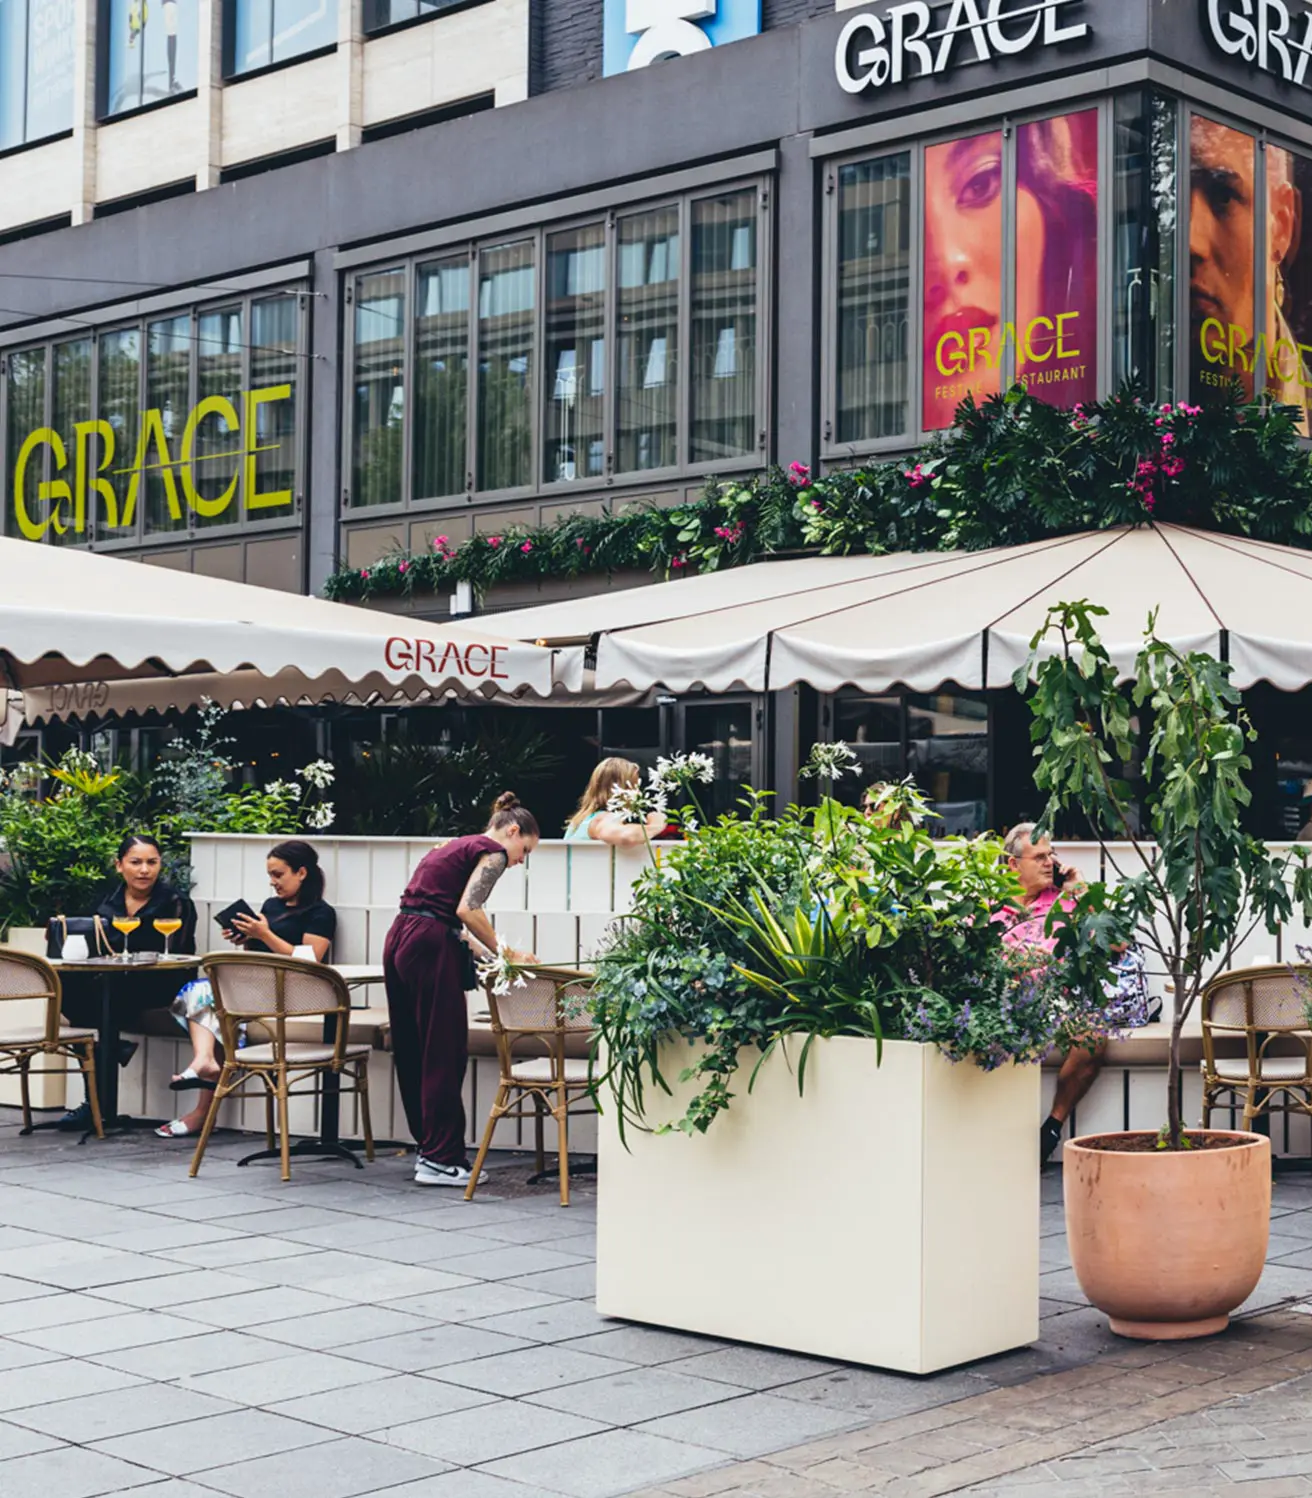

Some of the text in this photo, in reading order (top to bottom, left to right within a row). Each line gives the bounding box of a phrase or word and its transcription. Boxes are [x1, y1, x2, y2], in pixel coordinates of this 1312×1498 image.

[835, 0, 1088, 93] GRACE
[935, 311, 1080, 376] GRACE
[14, 383, 293, 540] GRACE
[384, 636, 509, 679] GRACE
